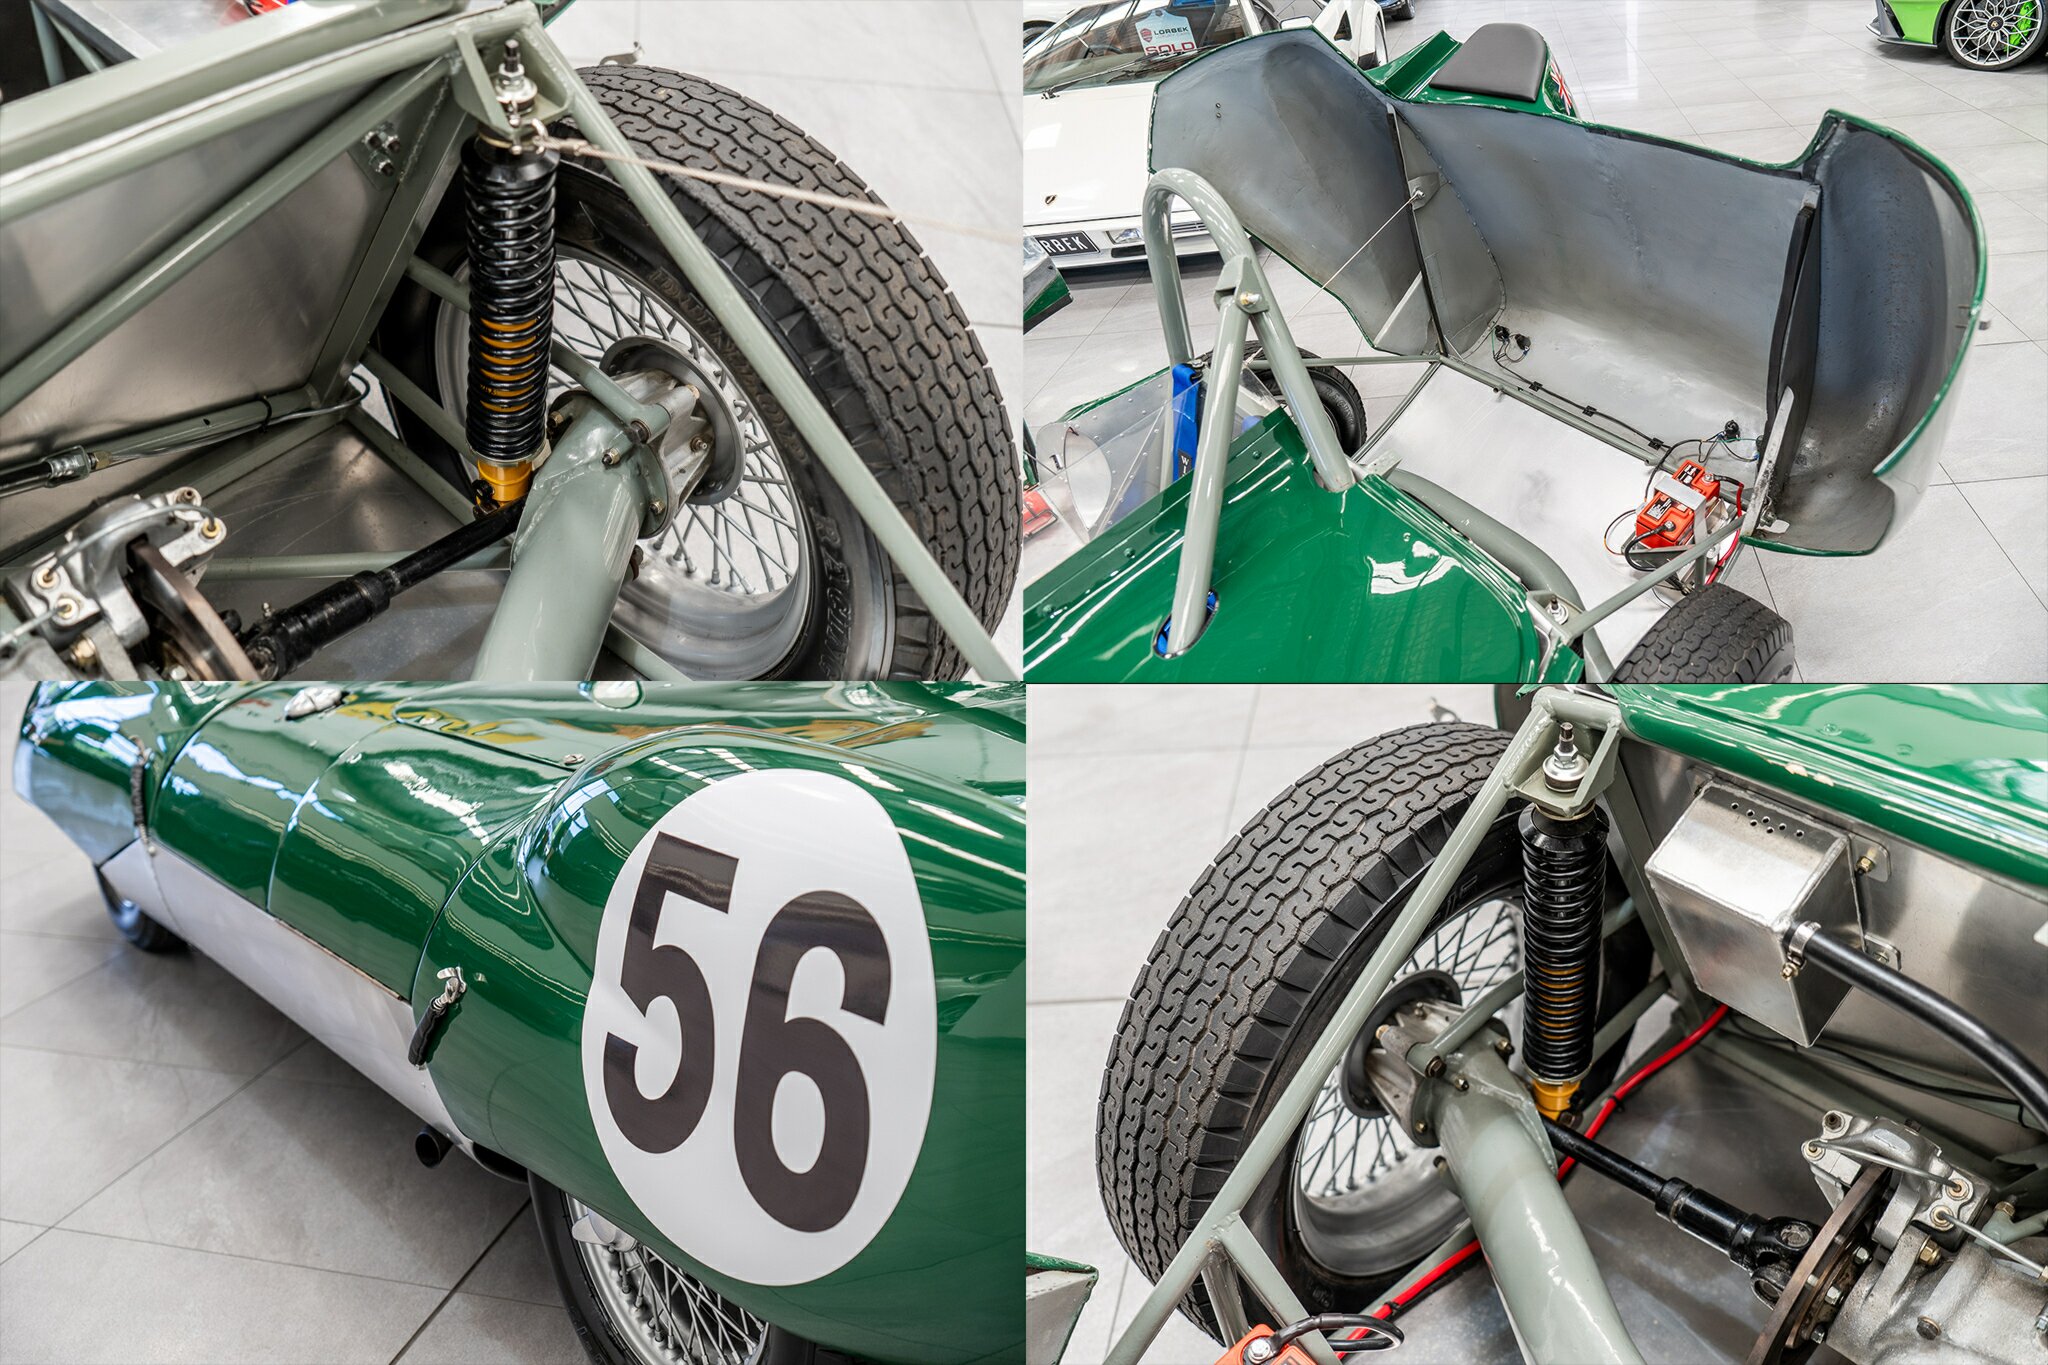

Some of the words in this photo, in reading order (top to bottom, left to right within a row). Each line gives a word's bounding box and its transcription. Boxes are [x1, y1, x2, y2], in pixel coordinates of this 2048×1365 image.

[1154, 27, 1189, 36] LORBEK
[1145, 41, 1195, 55] SOLD
[602, 830, 892, 1233] 56
